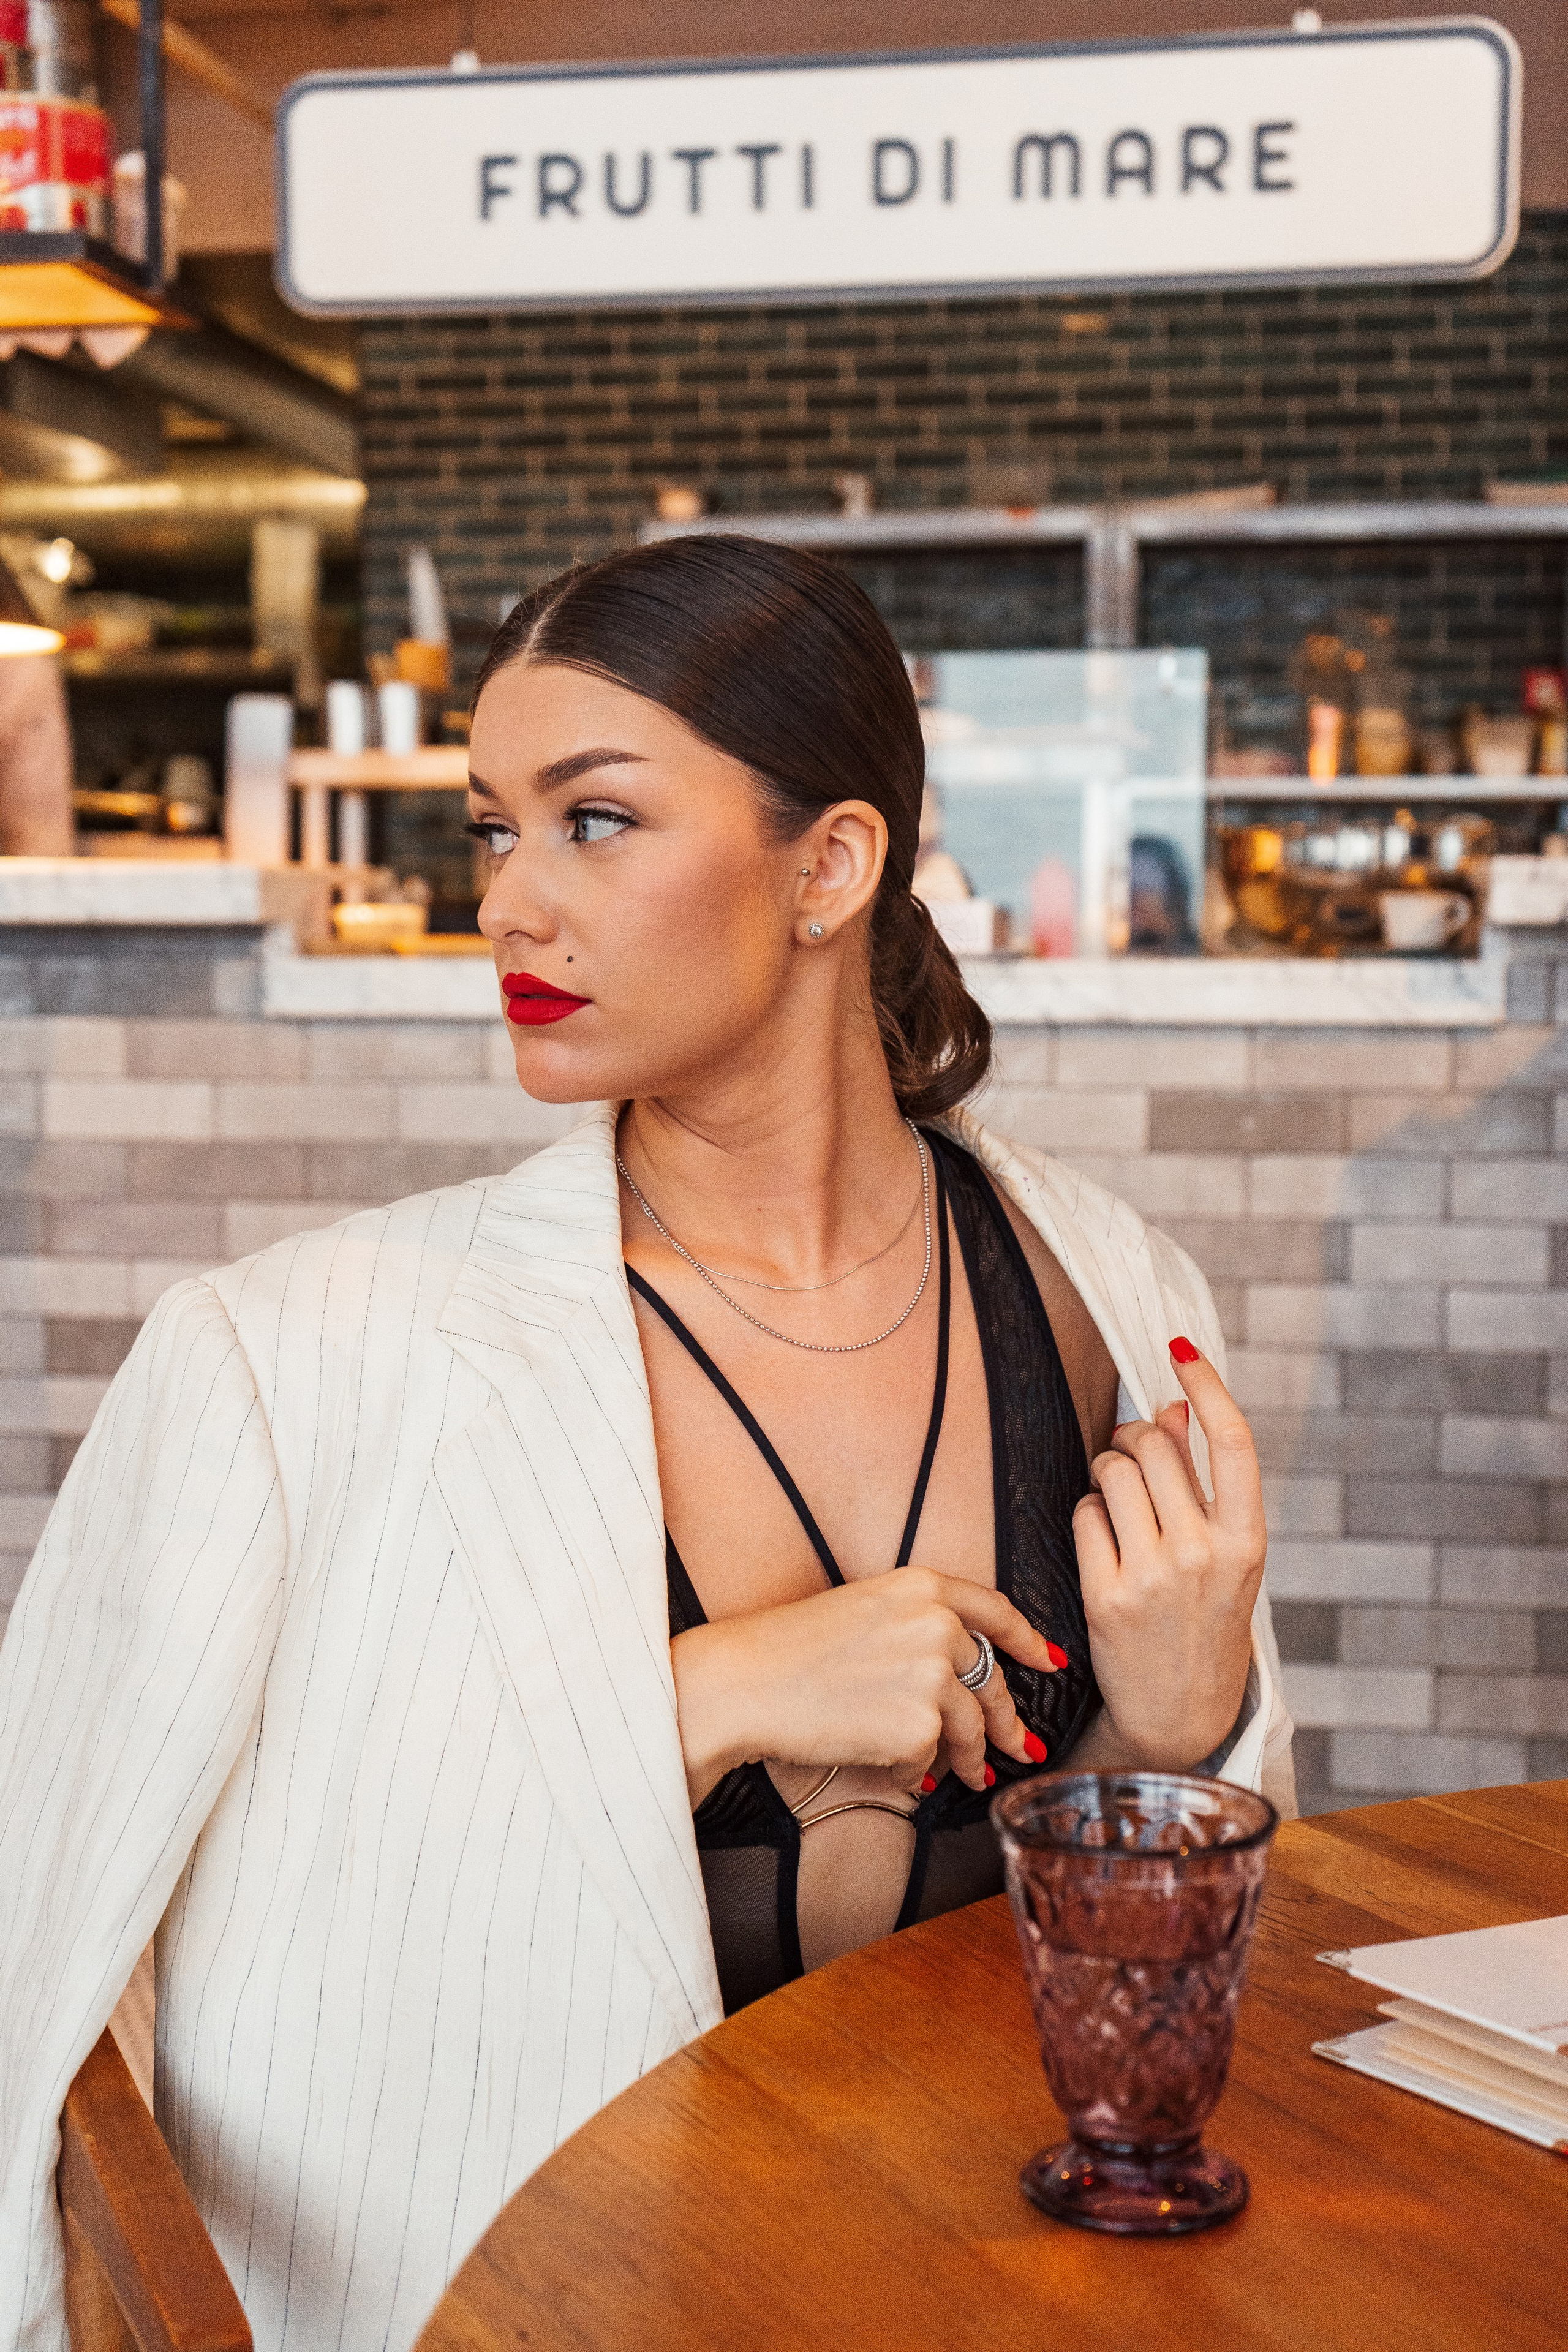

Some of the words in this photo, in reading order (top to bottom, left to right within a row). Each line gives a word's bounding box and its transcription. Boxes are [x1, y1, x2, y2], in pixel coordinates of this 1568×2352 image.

[478, 143, 815, 221] FRUTTI
[871, 137, 956, 208] DI
[1012, 121, 1295, 200] MARE
